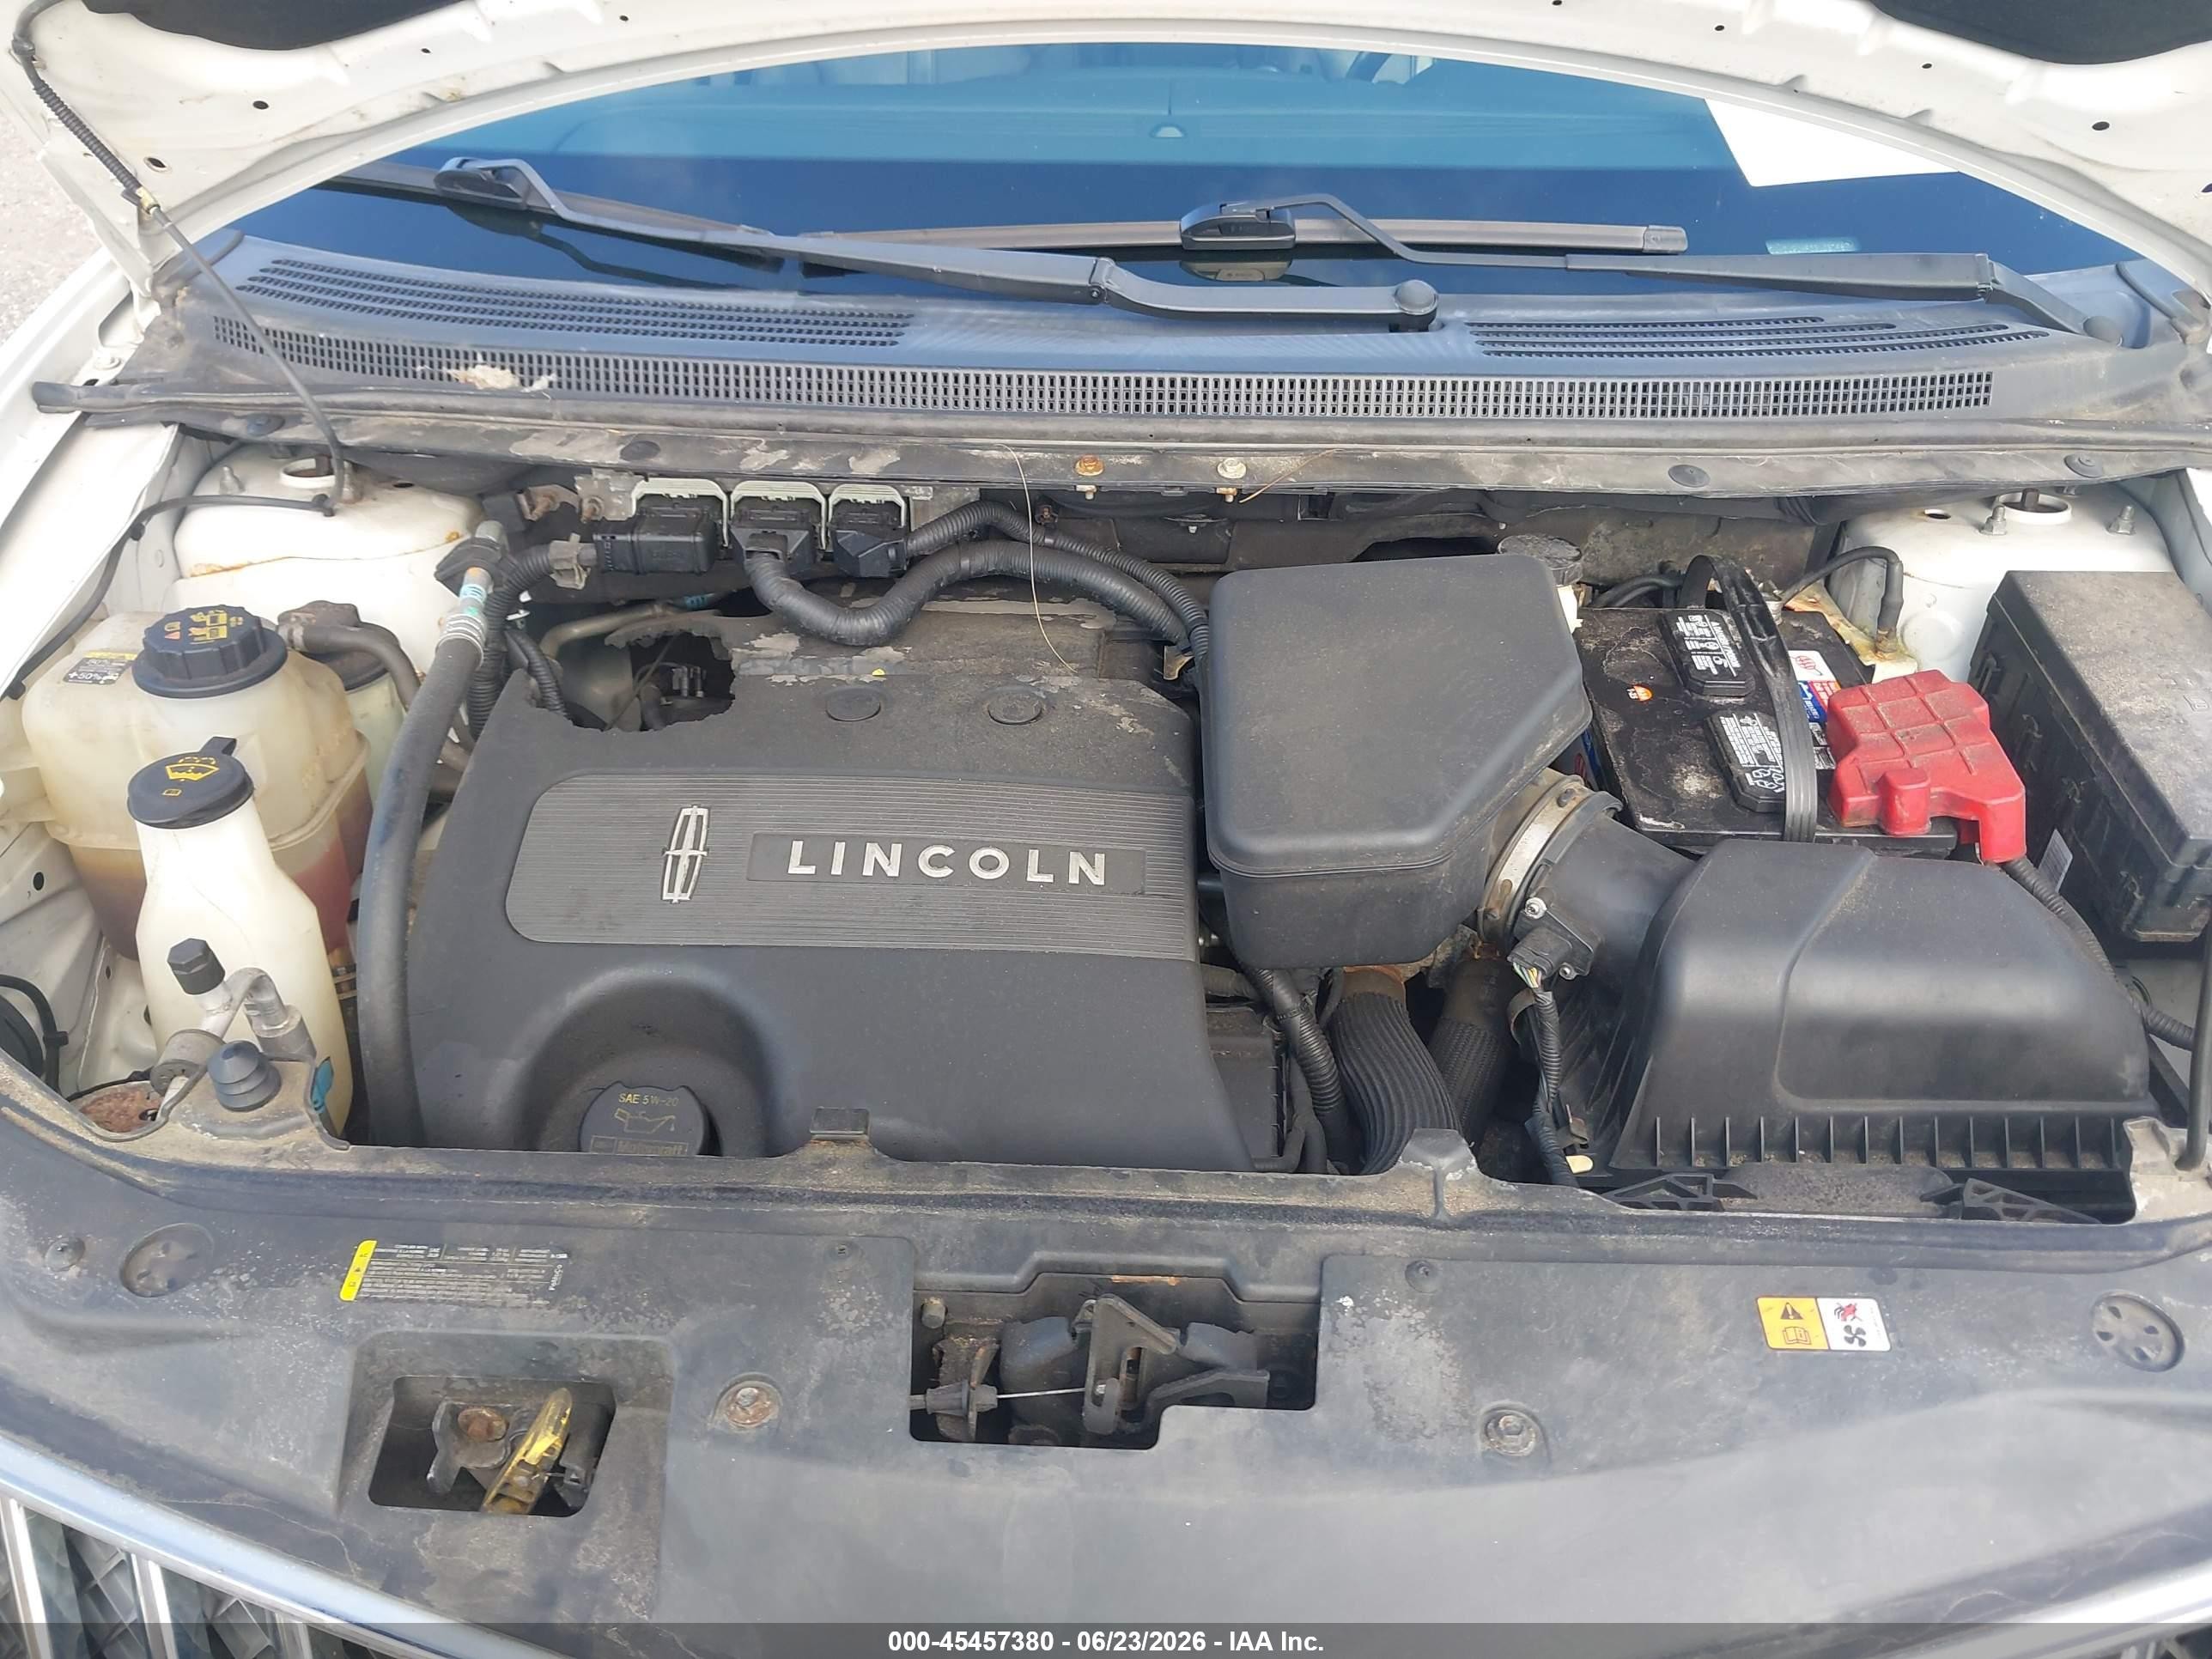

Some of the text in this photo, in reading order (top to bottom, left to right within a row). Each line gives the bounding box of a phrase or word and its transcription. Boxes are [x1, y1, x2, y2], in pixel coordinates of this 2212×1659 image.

[787, 839, 1106, 886] LINCOLN
[618, 1093, 680, 1107] SAE 5W-20
